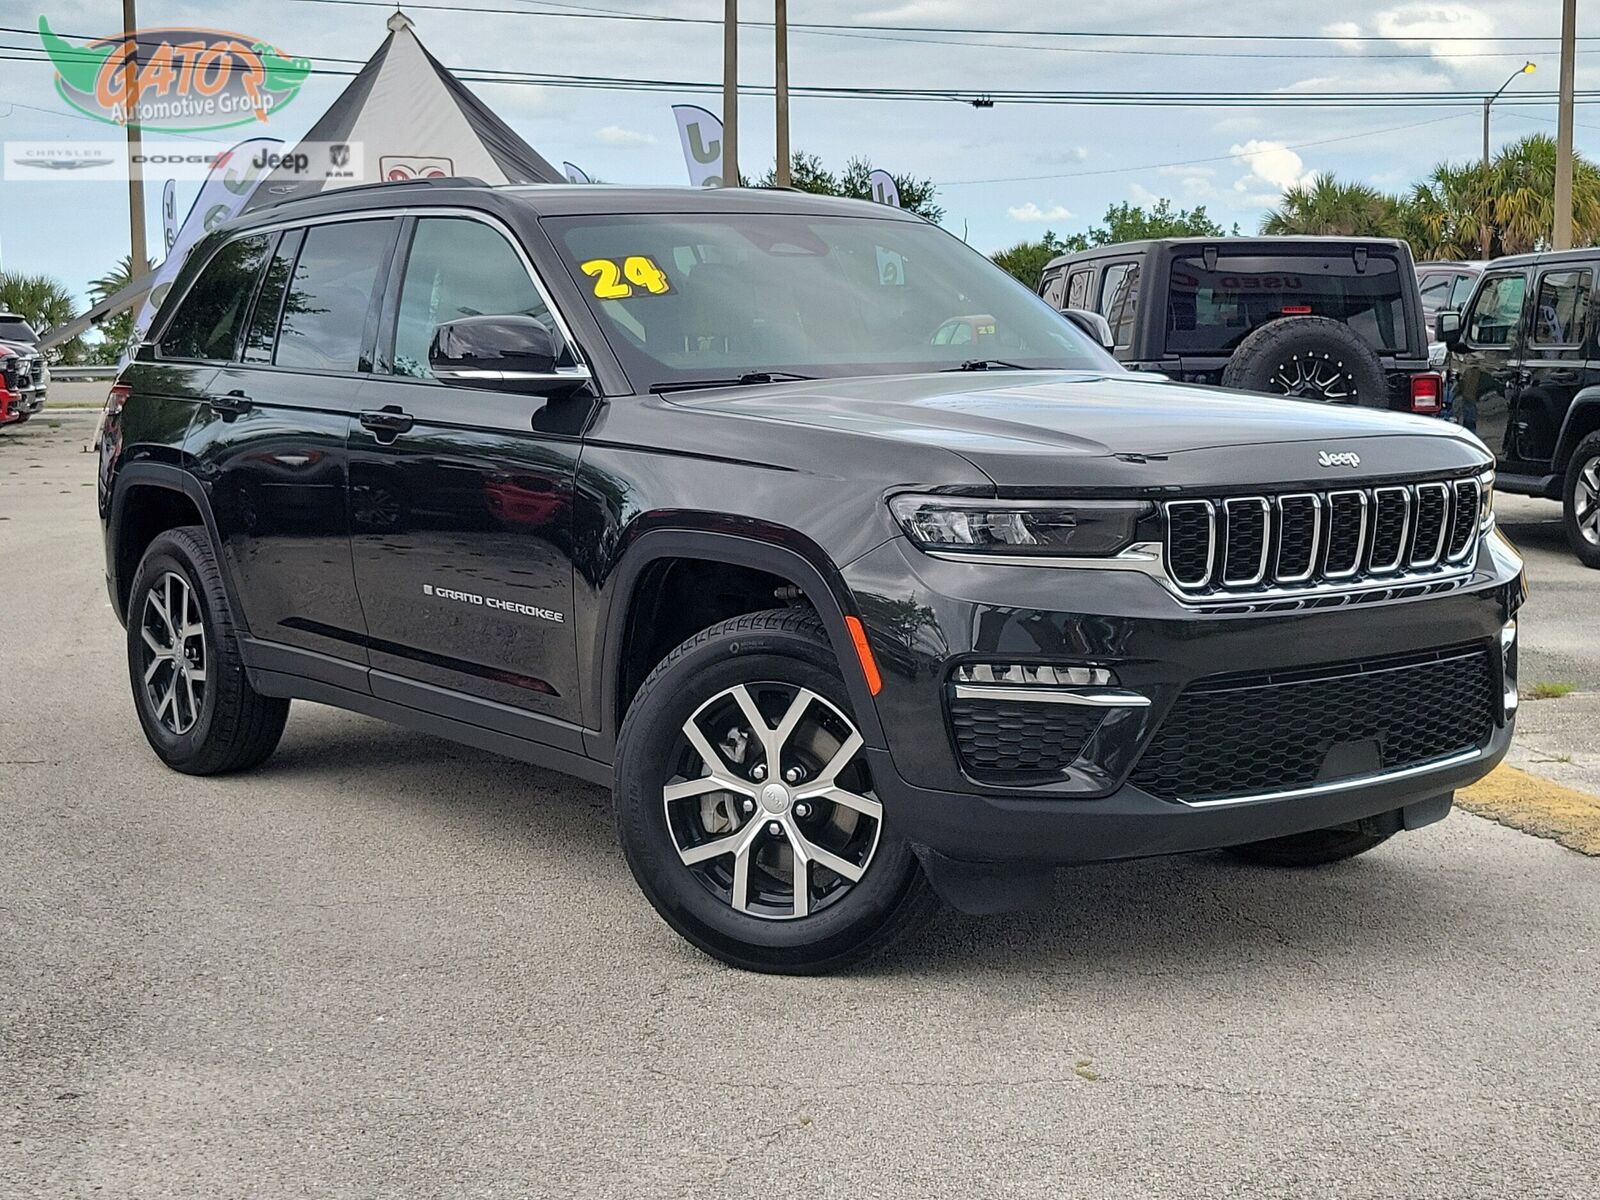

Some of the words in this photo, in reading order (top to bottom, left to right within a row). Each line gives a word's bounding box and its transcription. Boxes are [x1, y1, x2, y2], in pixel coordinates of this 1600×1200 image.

[580, 256, 670, 299] 24
[1318, 450, 1361, 468] Jeep
[435, 587, 483, 605] GRAND
[486, 597, 564, 624] CHEROKEE
